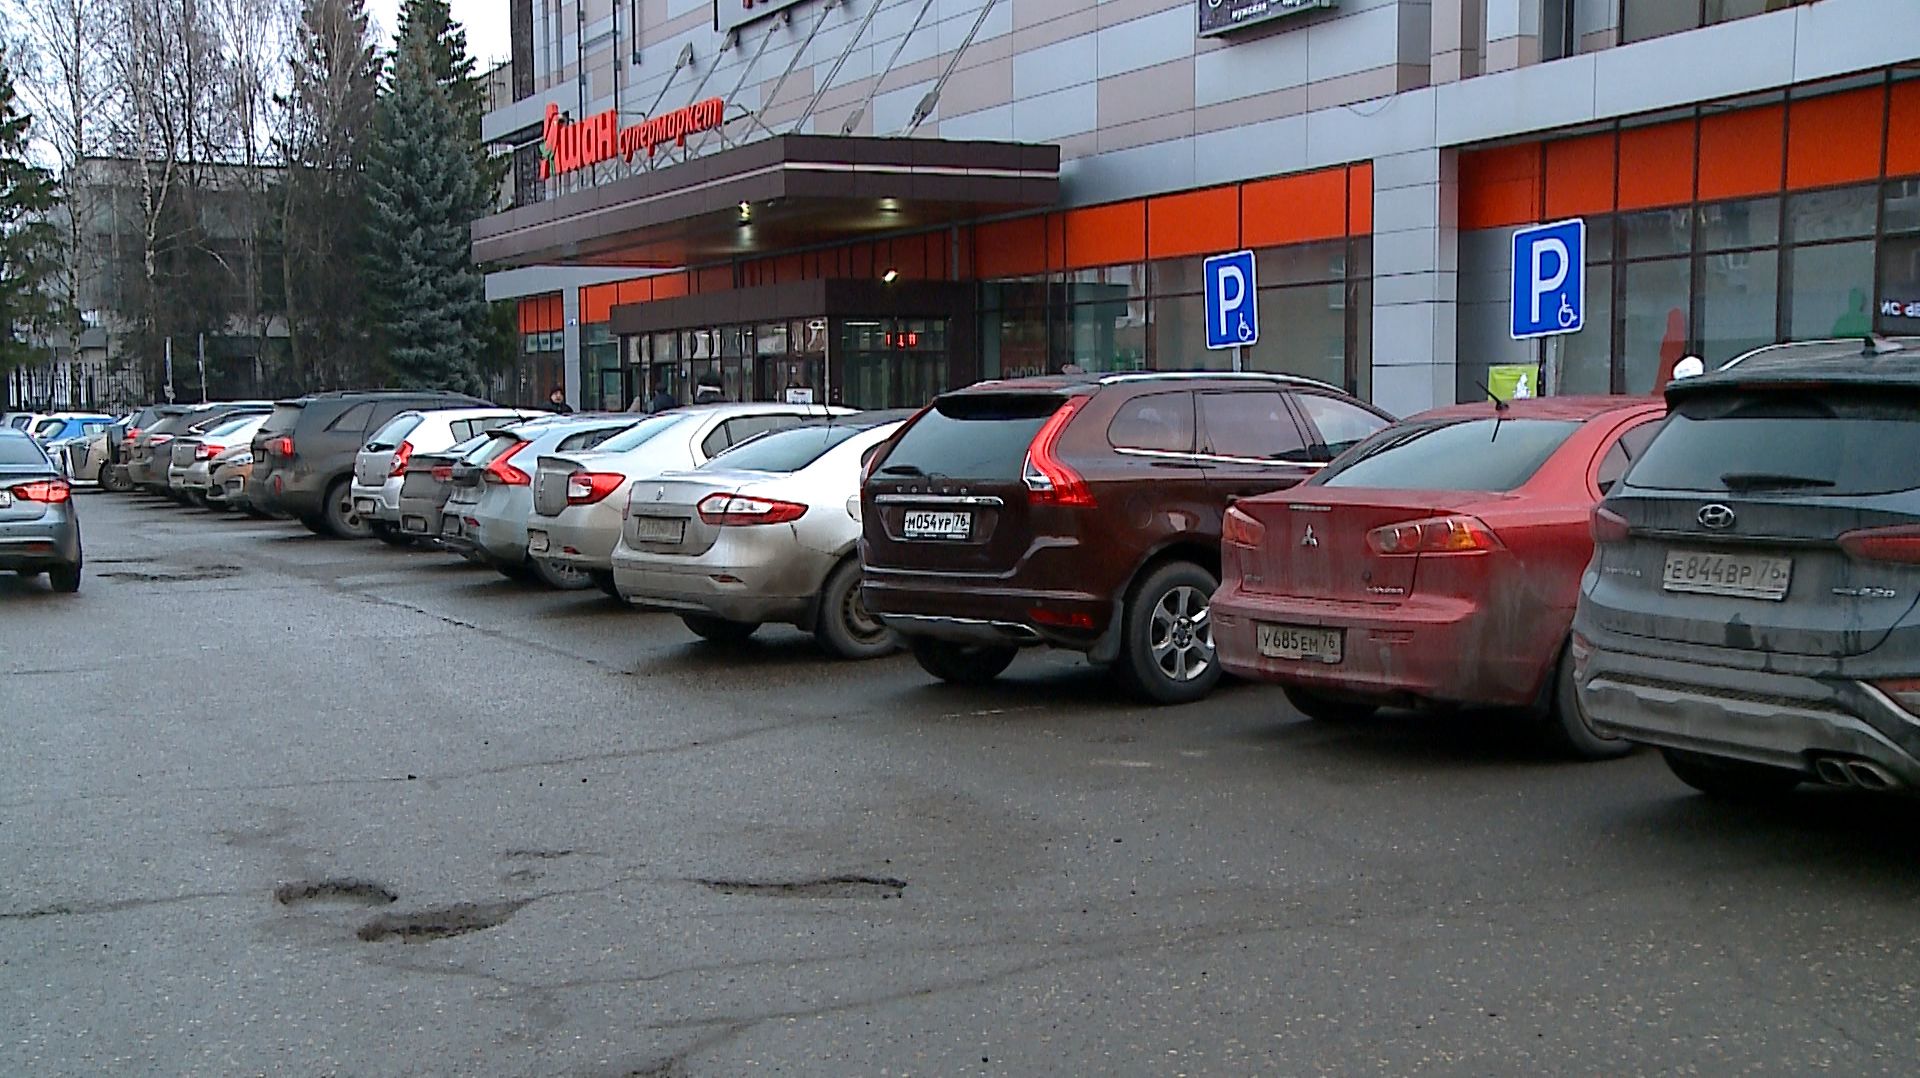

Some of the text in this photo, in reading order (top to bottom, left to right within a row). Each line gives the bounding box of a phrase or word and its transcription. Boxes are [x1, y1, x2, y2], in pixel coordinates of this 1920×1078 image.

[539, 96, 724, 181] Ашан супермаркет
[1218, 265, 1246, 336] P
[1531, 238, 1569, 323] P
[896, 486, 968, 494] VOLVO
